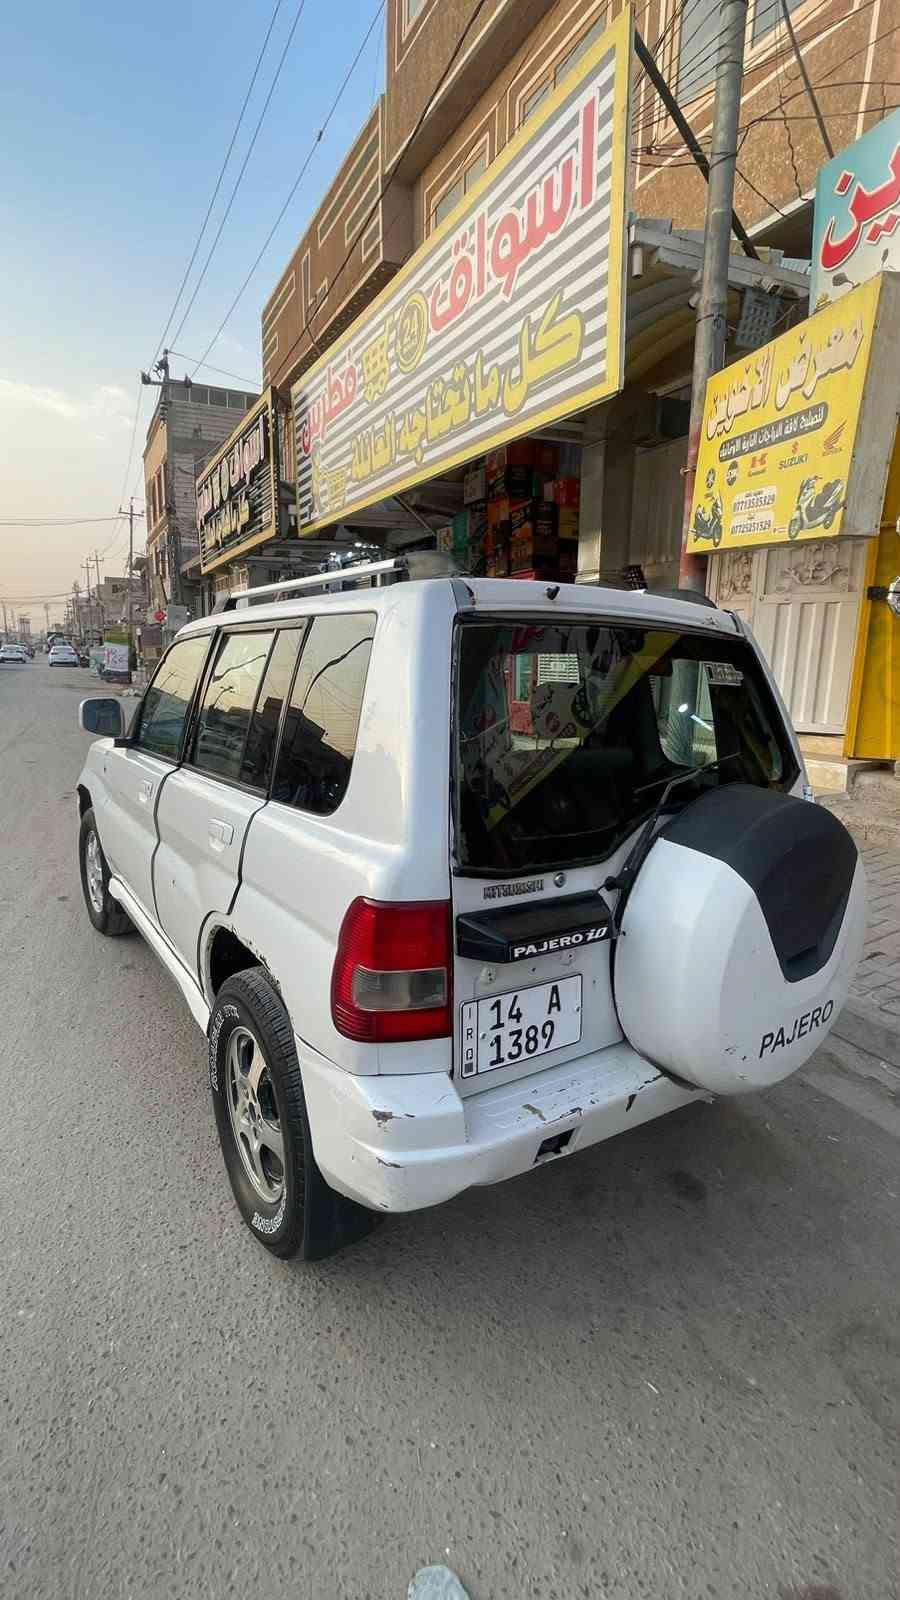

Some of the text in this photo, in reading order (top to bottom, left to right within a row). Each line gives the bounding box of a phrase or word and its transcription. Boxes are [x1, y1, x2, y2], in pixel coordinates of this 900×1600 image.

[430, 95, 597, 332] اسواق
[502, 286, 585, 416] كل
[775, 313, 864, 411] معرض
[474, 350, 500, 416] ما
[778, 453, 808, 470] SUZUKI
[514, 934, 583, 958] PAJERO
[489, 985, 561, 1030] 14 A
[759, 999, 834, 1058] PAJERO
[489, 1020, 555, 1066] 1389
